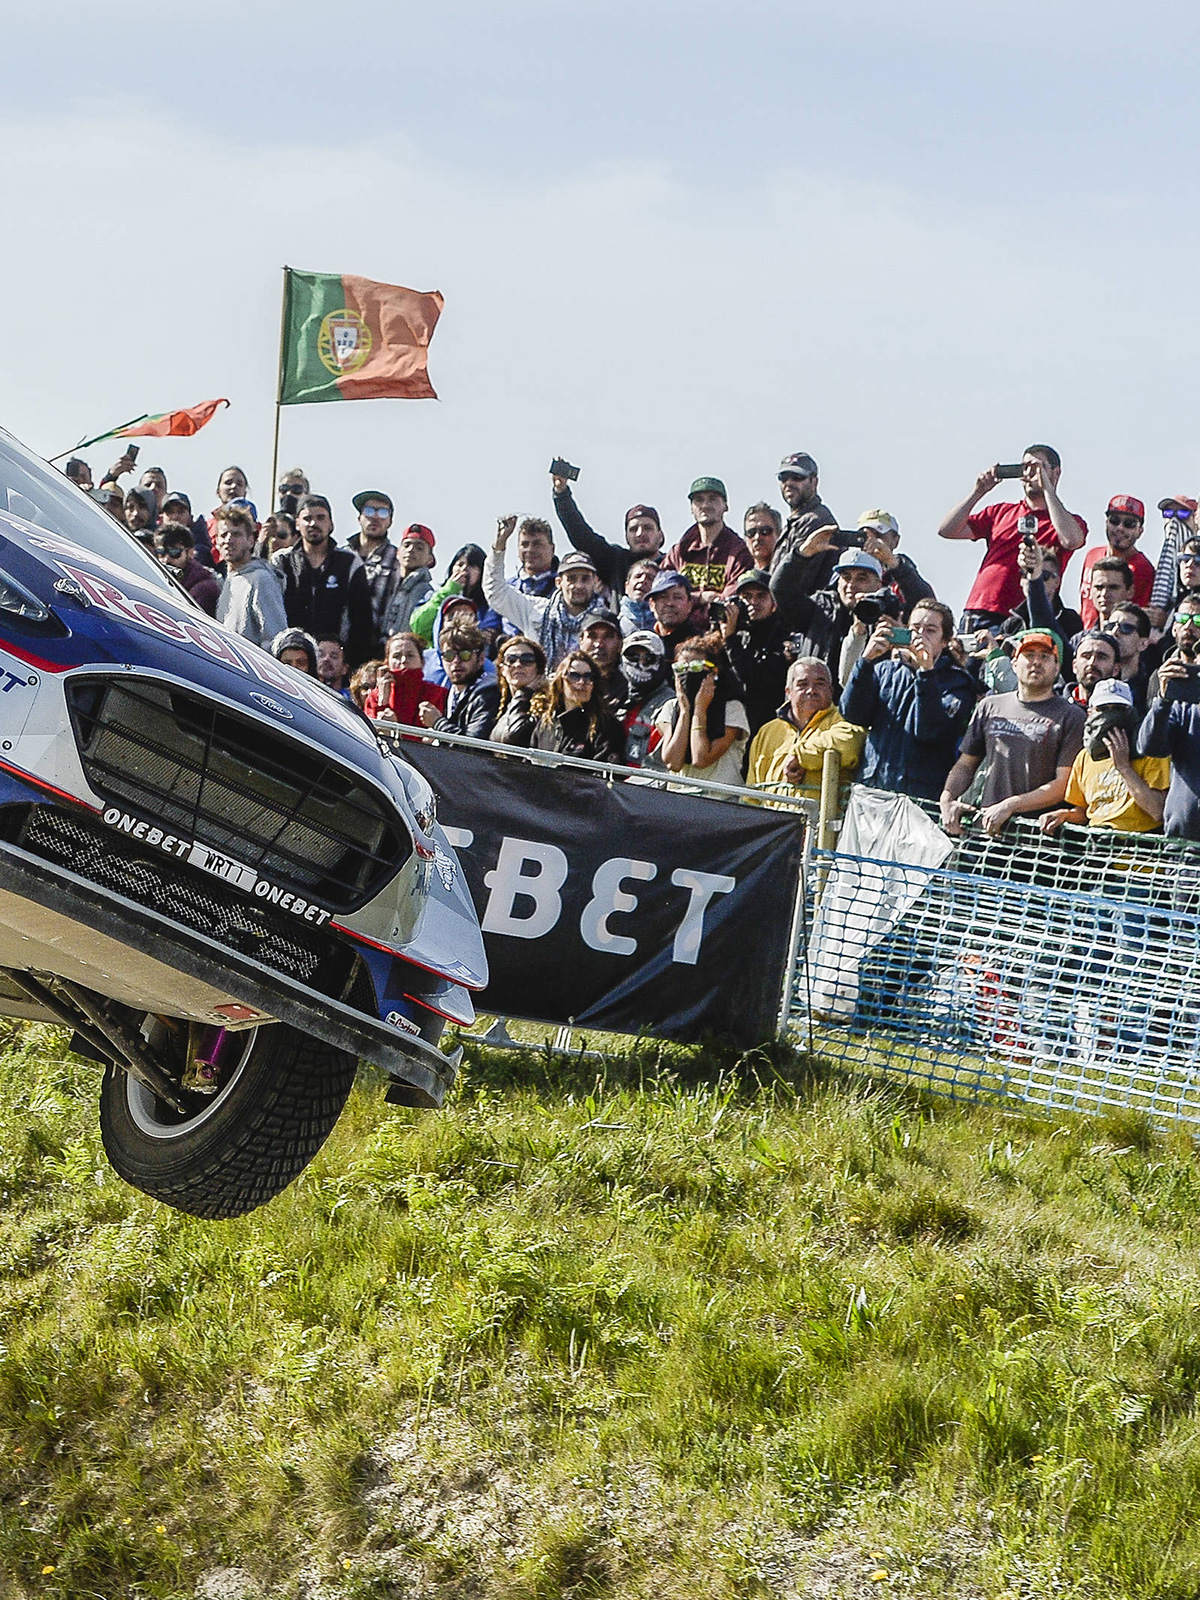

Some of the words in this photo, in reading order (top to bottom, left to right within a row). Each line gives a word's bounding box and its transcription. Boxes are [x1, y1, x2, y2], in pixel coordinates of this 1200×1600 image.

[56, 562, 248, 673] Red
[103, 807, 191, 857] ONEBET
[204, 850, 234, 877] WRT
[255, 880, 331, 926] ONEBET
[441, 826, 736, 965] BET
